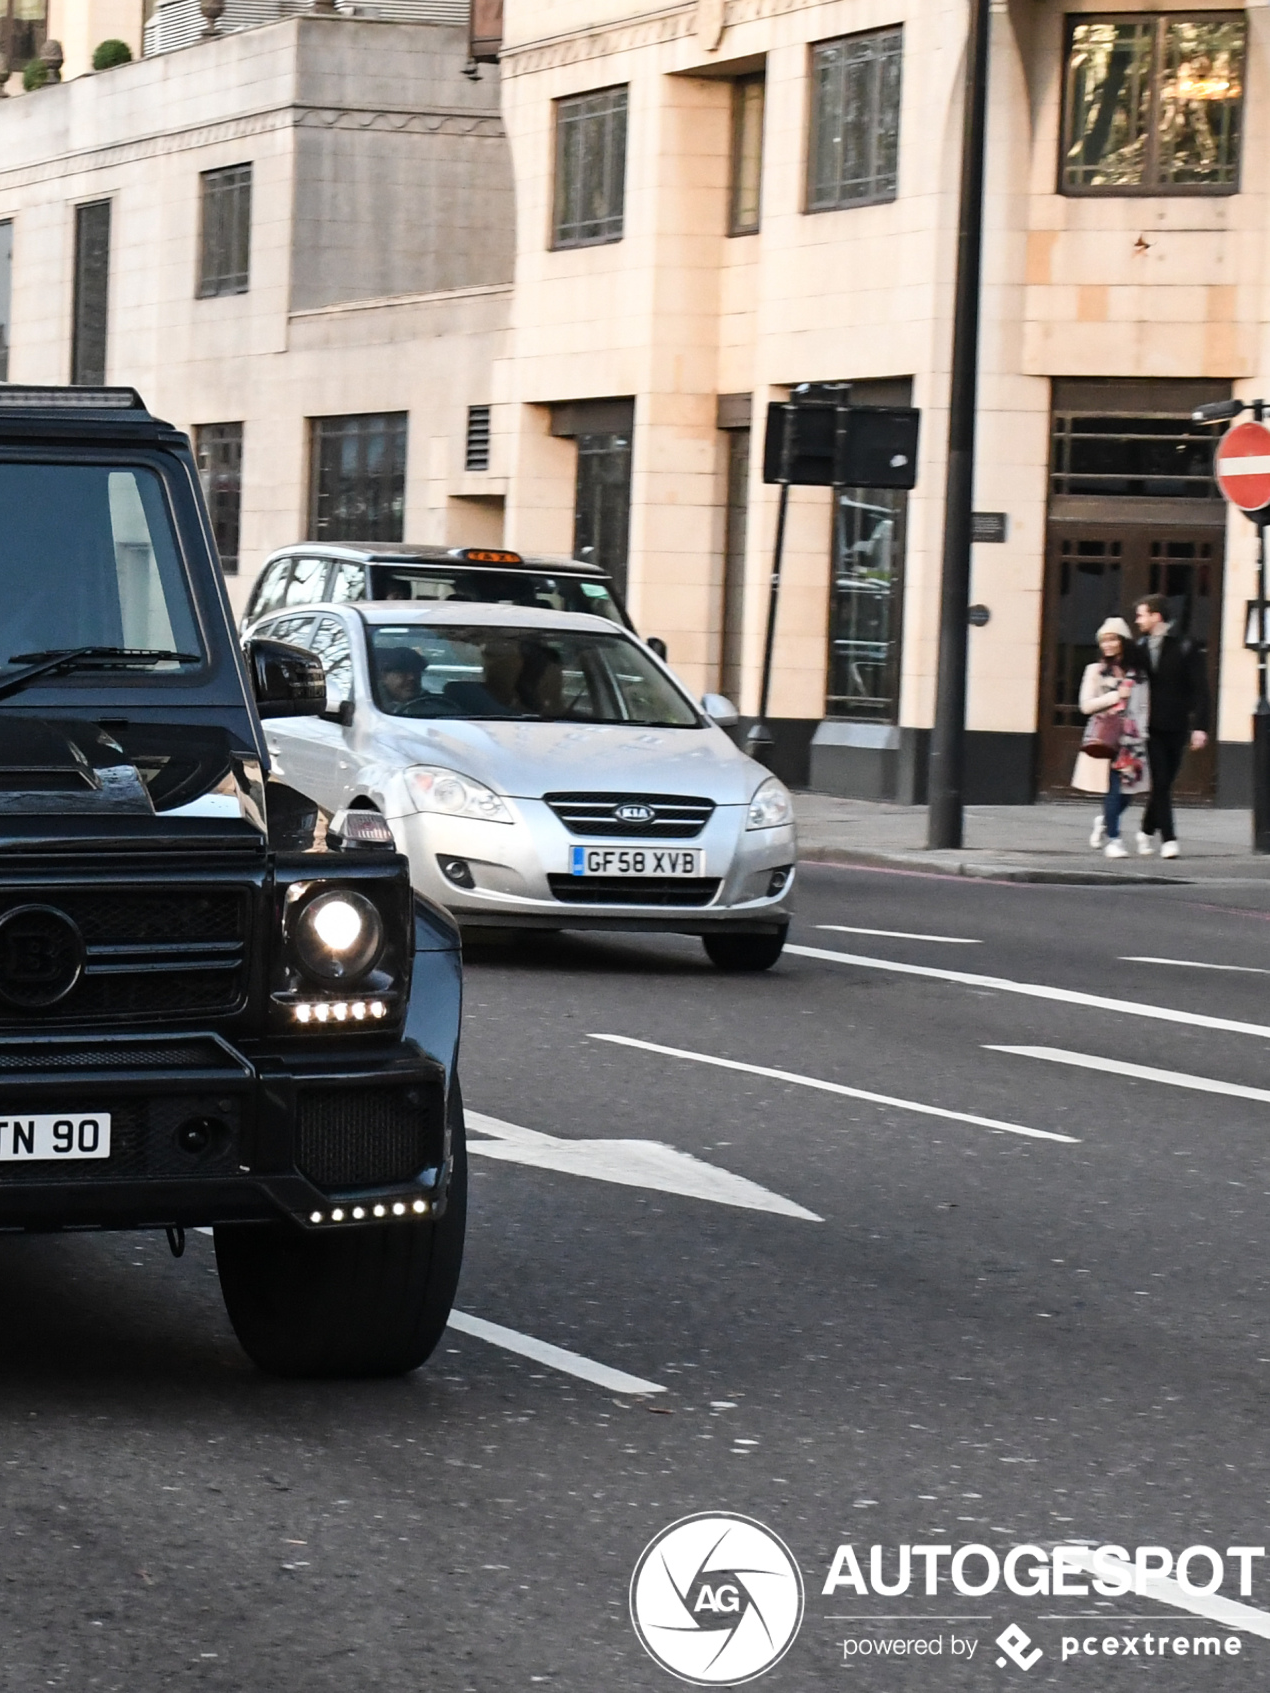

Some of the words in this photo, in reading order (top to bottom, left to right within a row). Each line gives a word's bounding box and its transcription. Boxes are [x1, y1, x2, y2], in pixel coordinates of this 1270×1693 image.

[470, 552, 518, 562] TAXI
[621, 807, 649, 818] KIA
[587, 851, 646, 873] GF58
[652, 852, 695, 873] XVB
[52, 1119, 100, 1153] 90
